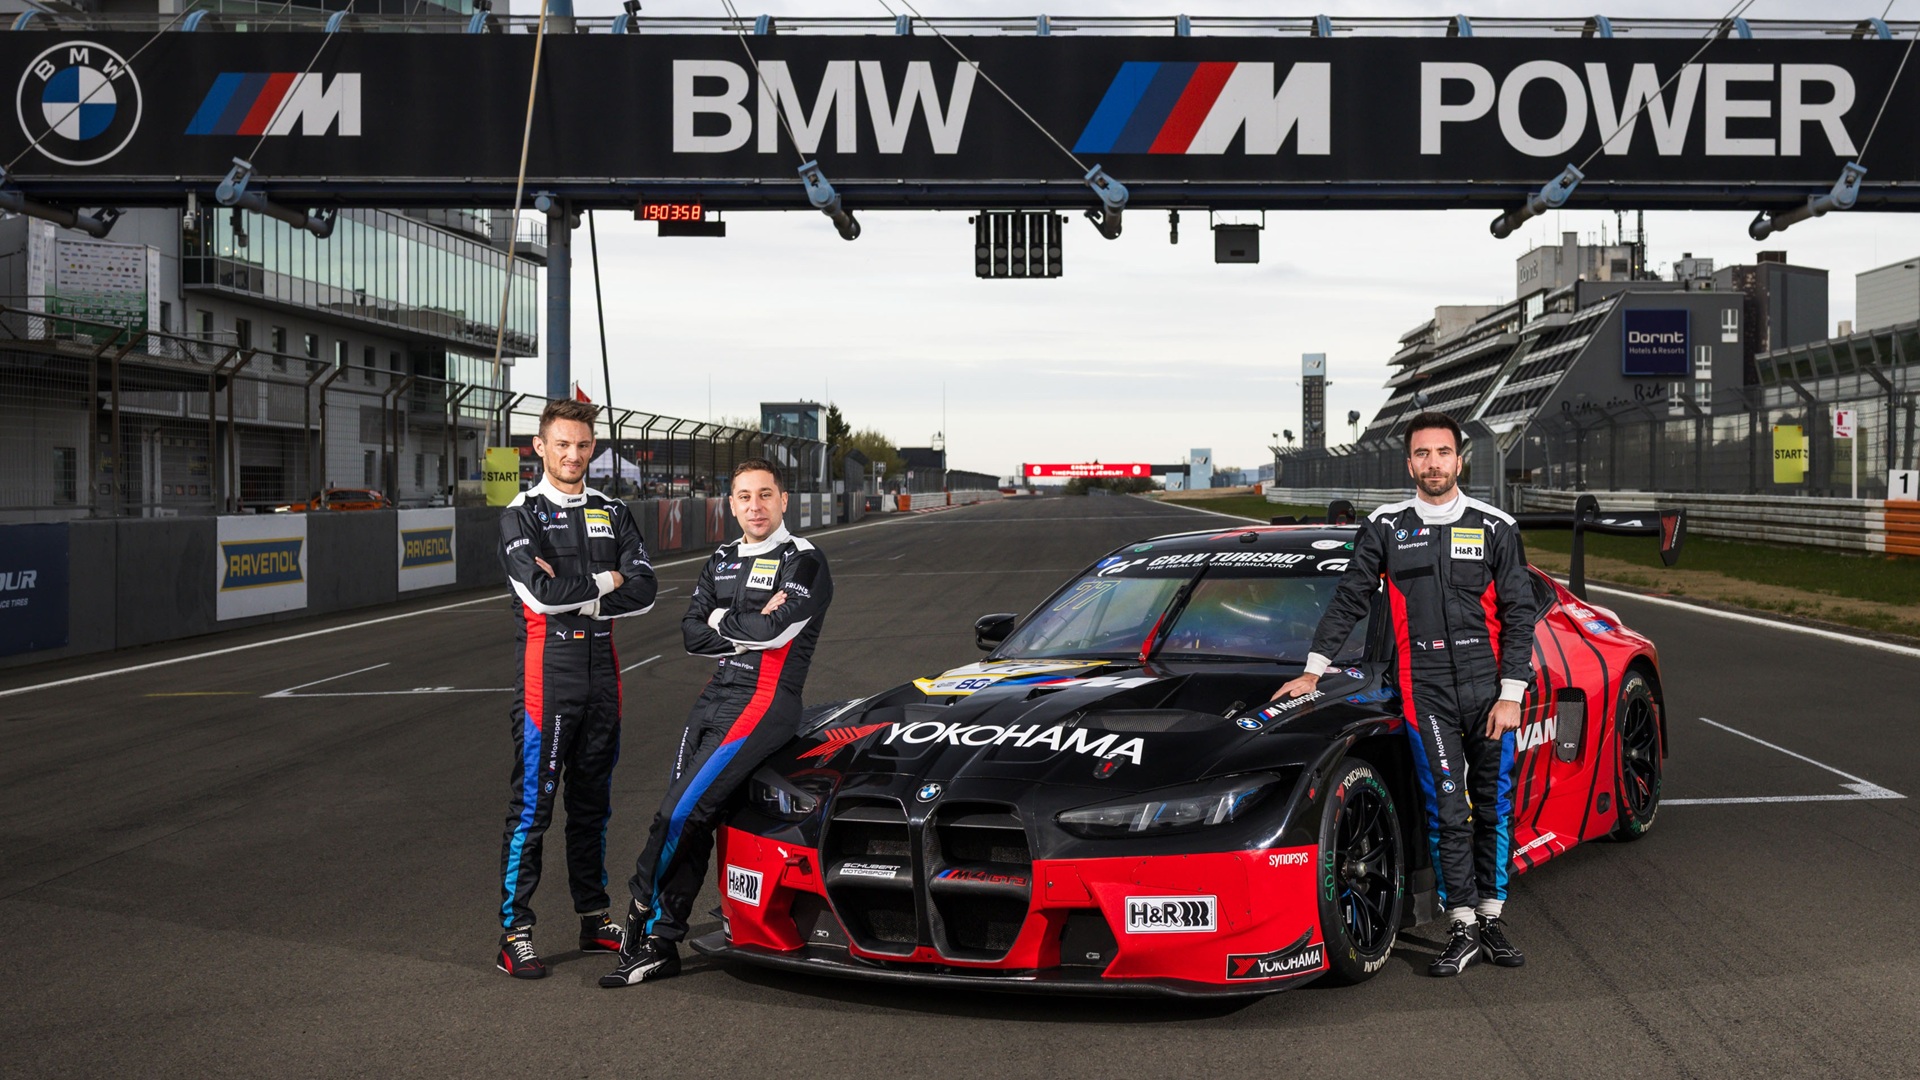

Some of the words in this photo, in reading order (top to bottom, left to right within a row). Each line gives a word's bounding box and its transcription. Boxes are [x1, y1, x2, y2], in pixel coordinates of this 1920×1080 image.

[672, 60, 979, 154] BMW
[1420, 60, 1858, 157] POWER
[643, 204, 701, 220] 19:03:58
[1628, 331, 1685, 344] Dorint
[1774, 449, 1802, 459] START
[487, 471, 518, 482] START
[1899, 473, 1908, 494] 1
[590, 526, 608, 534] H&R
[406, 537, 450, 559] RAVENOL
[1397, 541, 1429, 550] Motorsport
[1455, 547, 1473, 555] H&R
[229, 550, 299, 577] RAVENOL
[1148, 553, 1211, 567] GRAN
[1210, 552, 1306, 564] TURISMO
[785, 582, 809, 595] FRIJNS
[1281, 689, 1326, 711] Motorsport
[550, 714, 561, 758] Motorsport
[883, 722, 1144, 764] YOKOHAMA
[1428, 715, 1446, 757] Motorsport
[1342, 766, 1373, 788] YOKOHAMA
[842, 869, 895, 877] MOTORSPORT
[843, 862, 900, 870] SCHUBERT
[729, 869, 746, 891] H&R
[952, 869, 985, 883] M4
[989, 874, 1028, 886] GT3
[1130, 902, 1180, 928] H&R
[1258, 950, 1321, 973] YOKOHAMA
